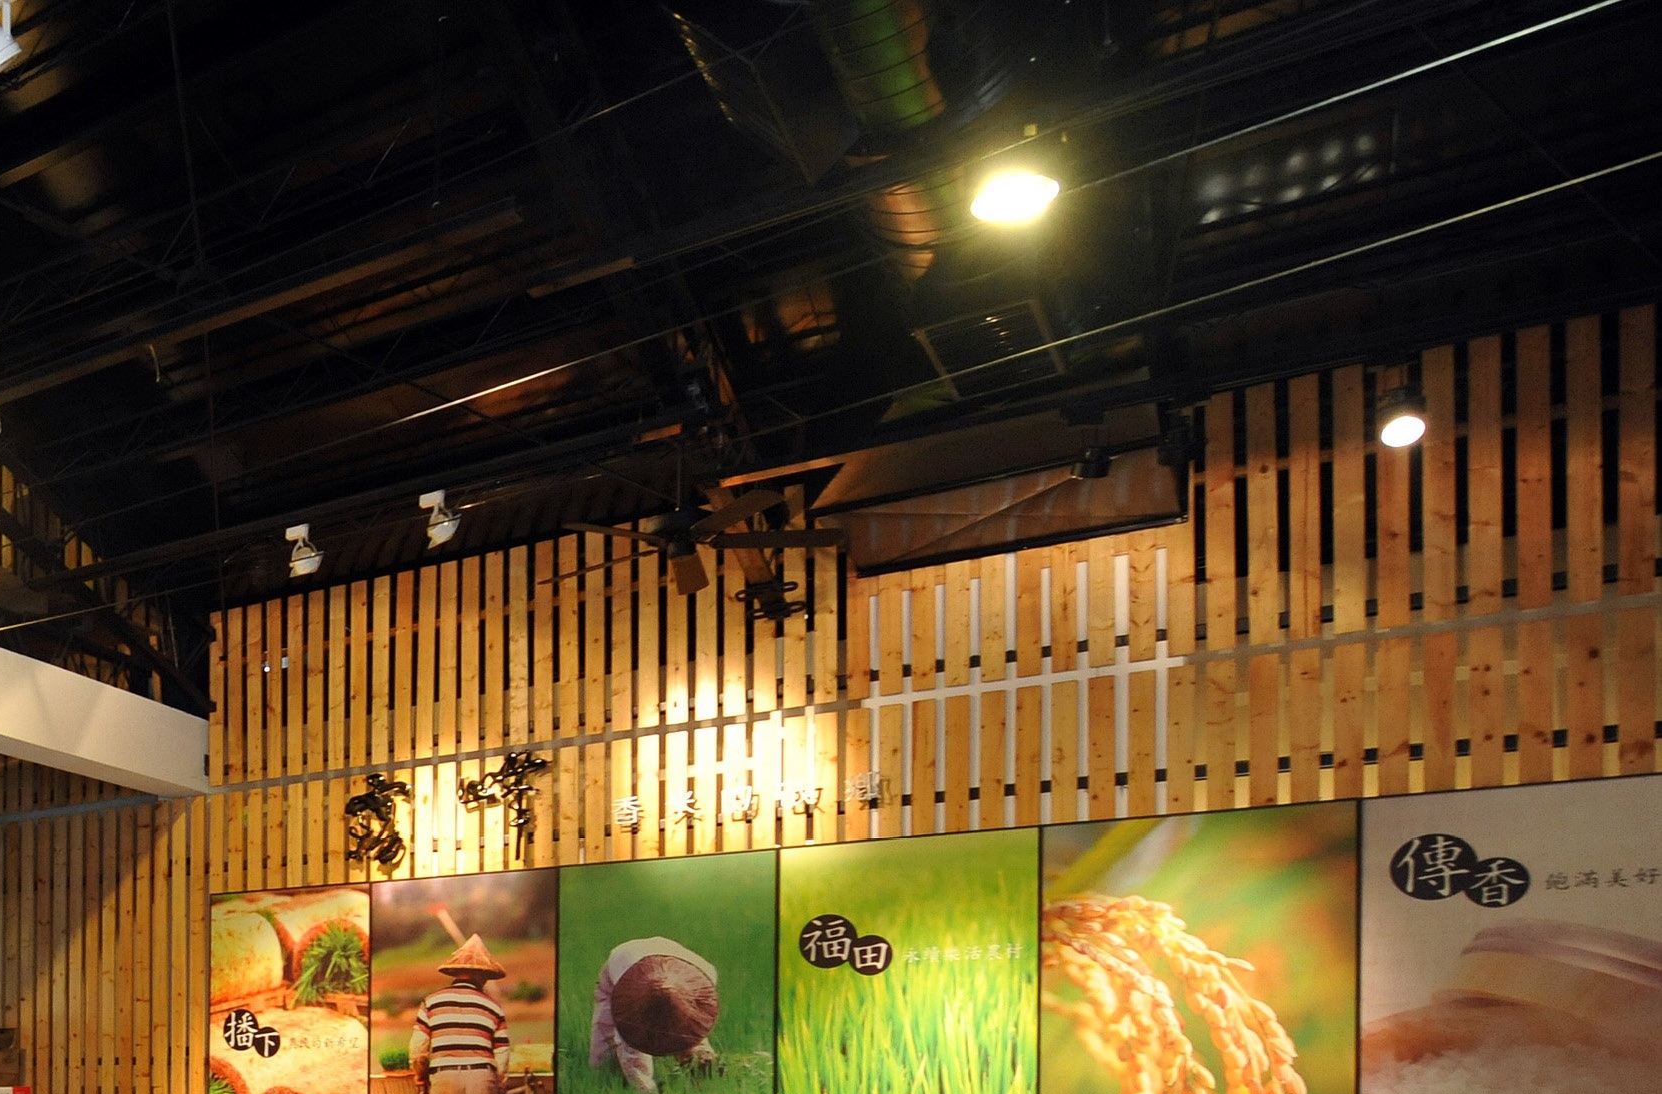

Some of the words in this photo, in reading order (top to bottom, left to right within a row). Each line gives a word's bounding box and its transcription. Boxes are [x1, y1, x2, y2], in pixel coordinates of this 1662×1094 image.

[1397, 836, 1526, 906] 傳香
[802, 919, 888, 969] 福田
[224, 1012, 280, 1058] 播下
